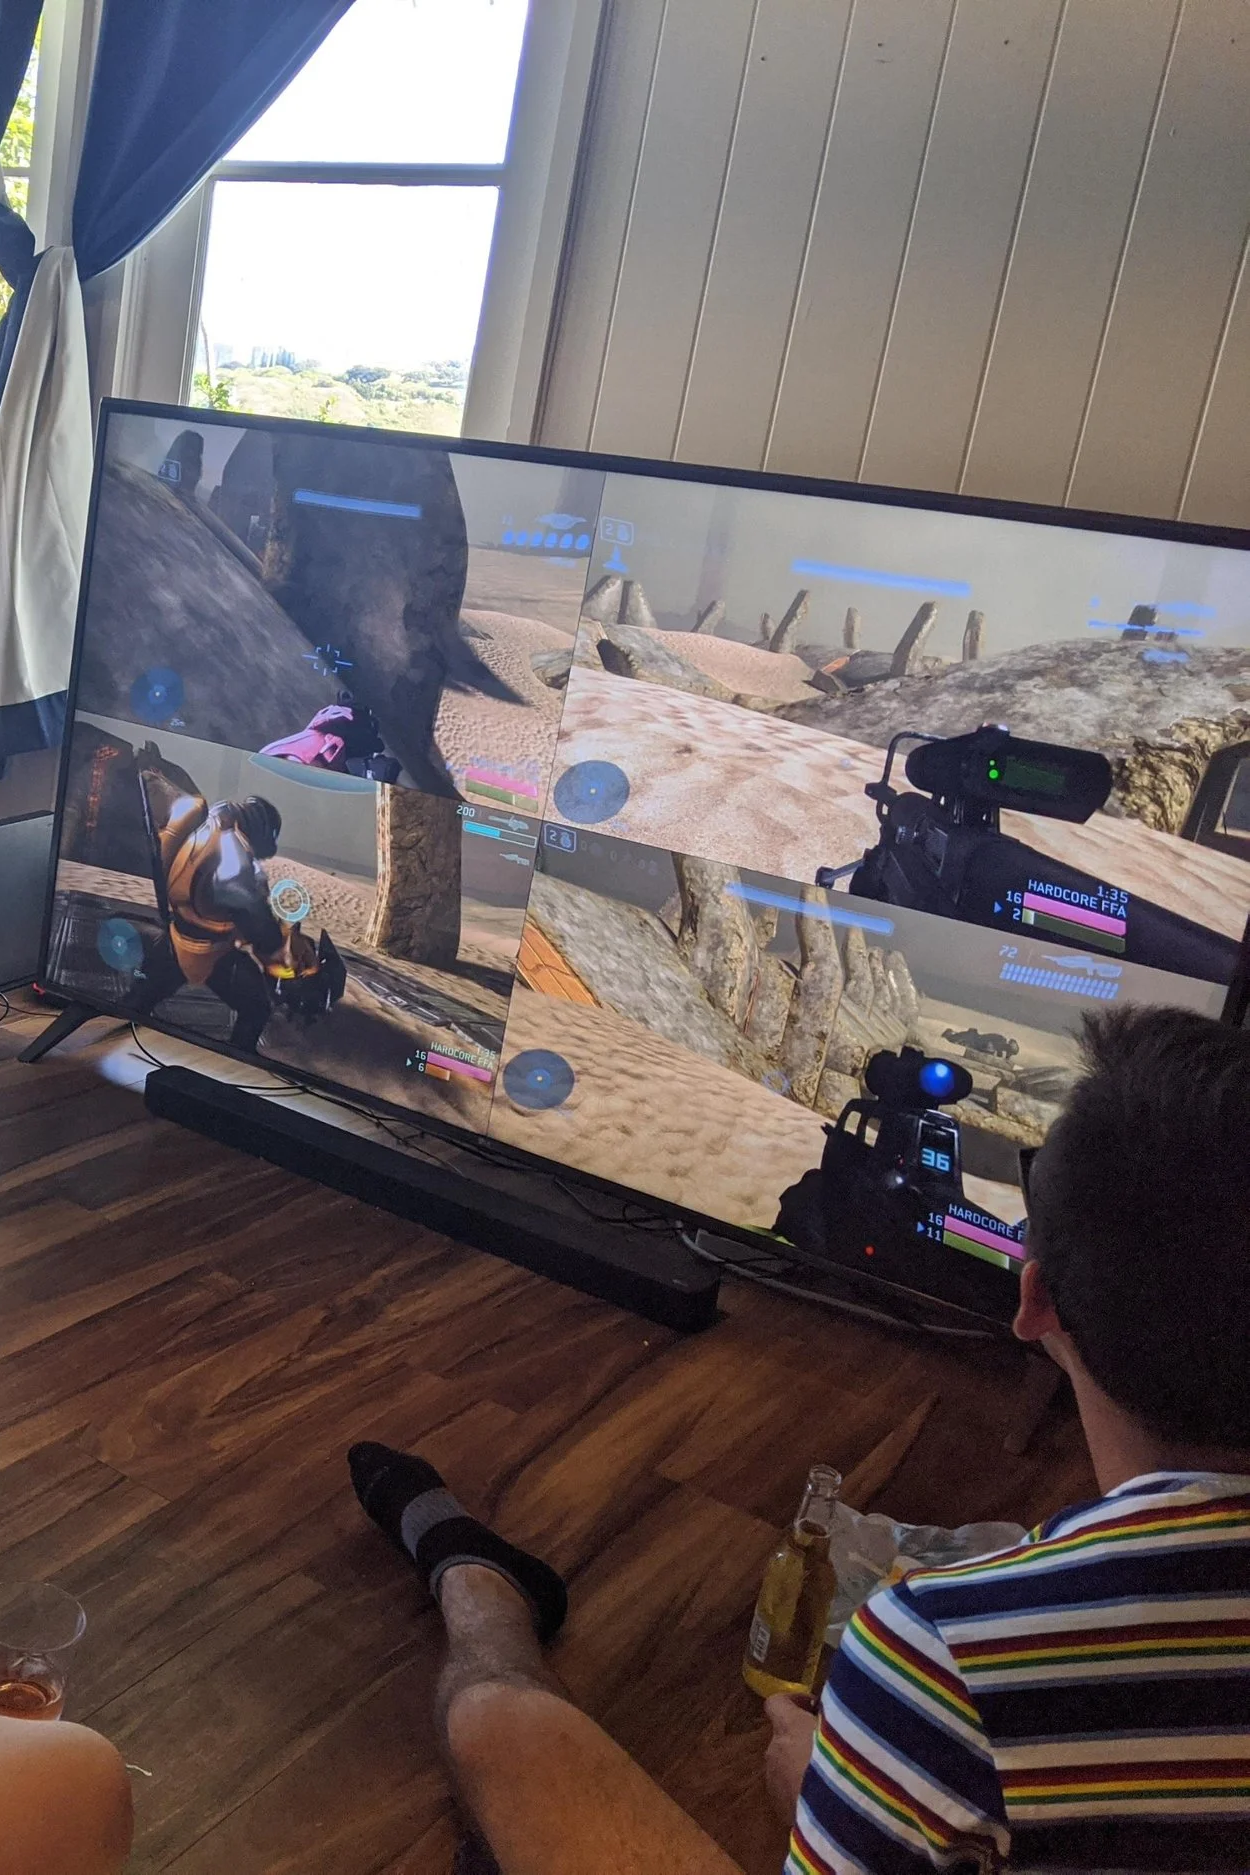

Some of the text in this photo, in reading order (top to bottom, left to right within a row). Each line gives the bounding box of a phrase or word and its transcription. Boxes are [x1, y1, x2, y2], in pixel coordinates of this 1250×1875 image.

[605, 523, 614, 536] 2
[456, 805, 475, 817] 200
[549, 830, 558, 841] 2
[1006, 890, 1022, 904] 16
[1028, 879, 1127, 918] HARDCORE FFA
[1097, 885, 1129, 904] 1:35
[1012, 908, 1021, 921] 2
[999, 945, 1018, 960] 72
[415, 1050, 427, 1061] 16
[431, 1041, 495, 1070] HARDCORE FFA
[418, 1063, 425, 1072] 6
[921, 1147, 950, 1172] 36
[928, 1212, 944, 1226] 16
[948, 1203, 1015, 1237] HARDCORE
[927, 1227, 941, 1241] 11
